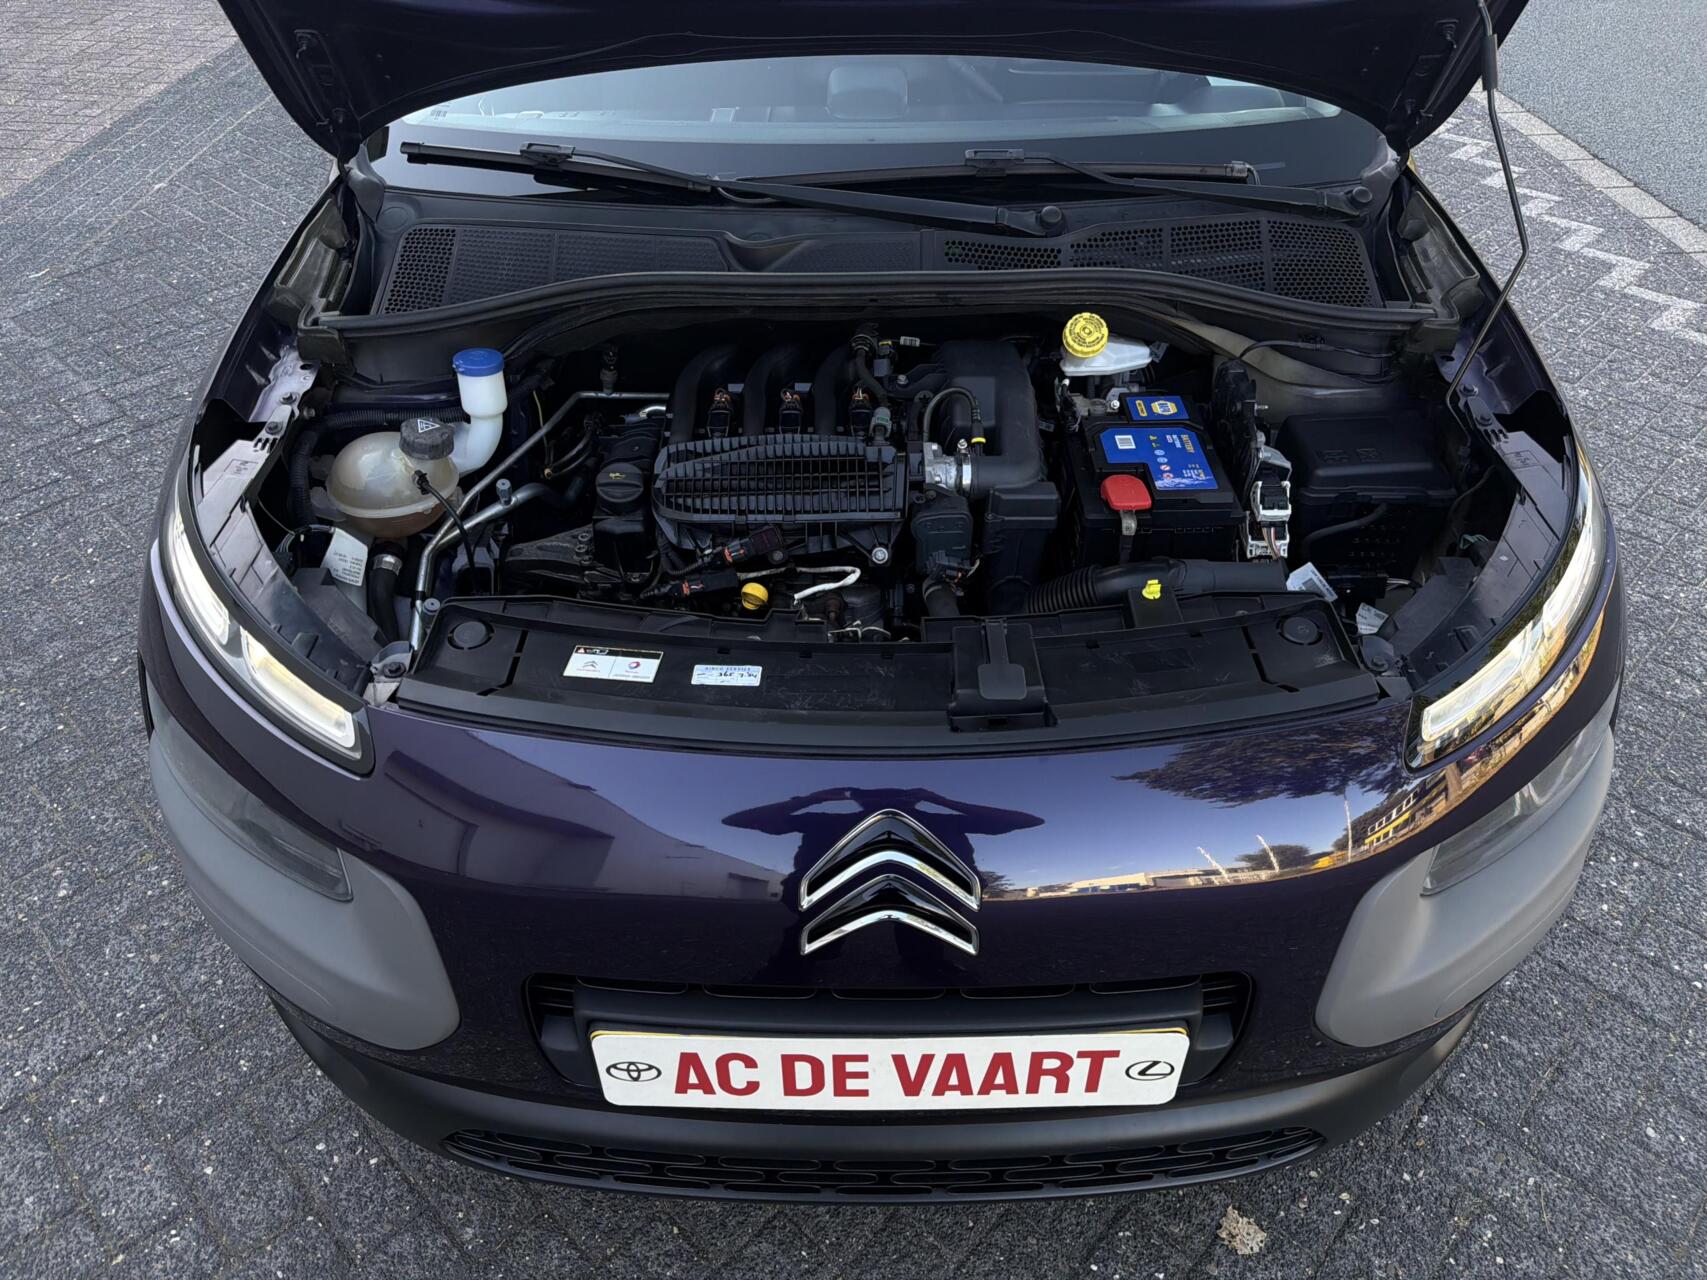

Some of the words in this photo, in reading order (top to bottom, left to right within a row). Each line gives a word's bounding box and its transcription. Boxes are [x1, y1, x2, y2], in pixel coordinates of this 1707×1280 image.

[674, 1052, 760, 1097] AC
[780, 1054, 870, 1097] DE
[891, 1050, 1120, 1097] VAART
